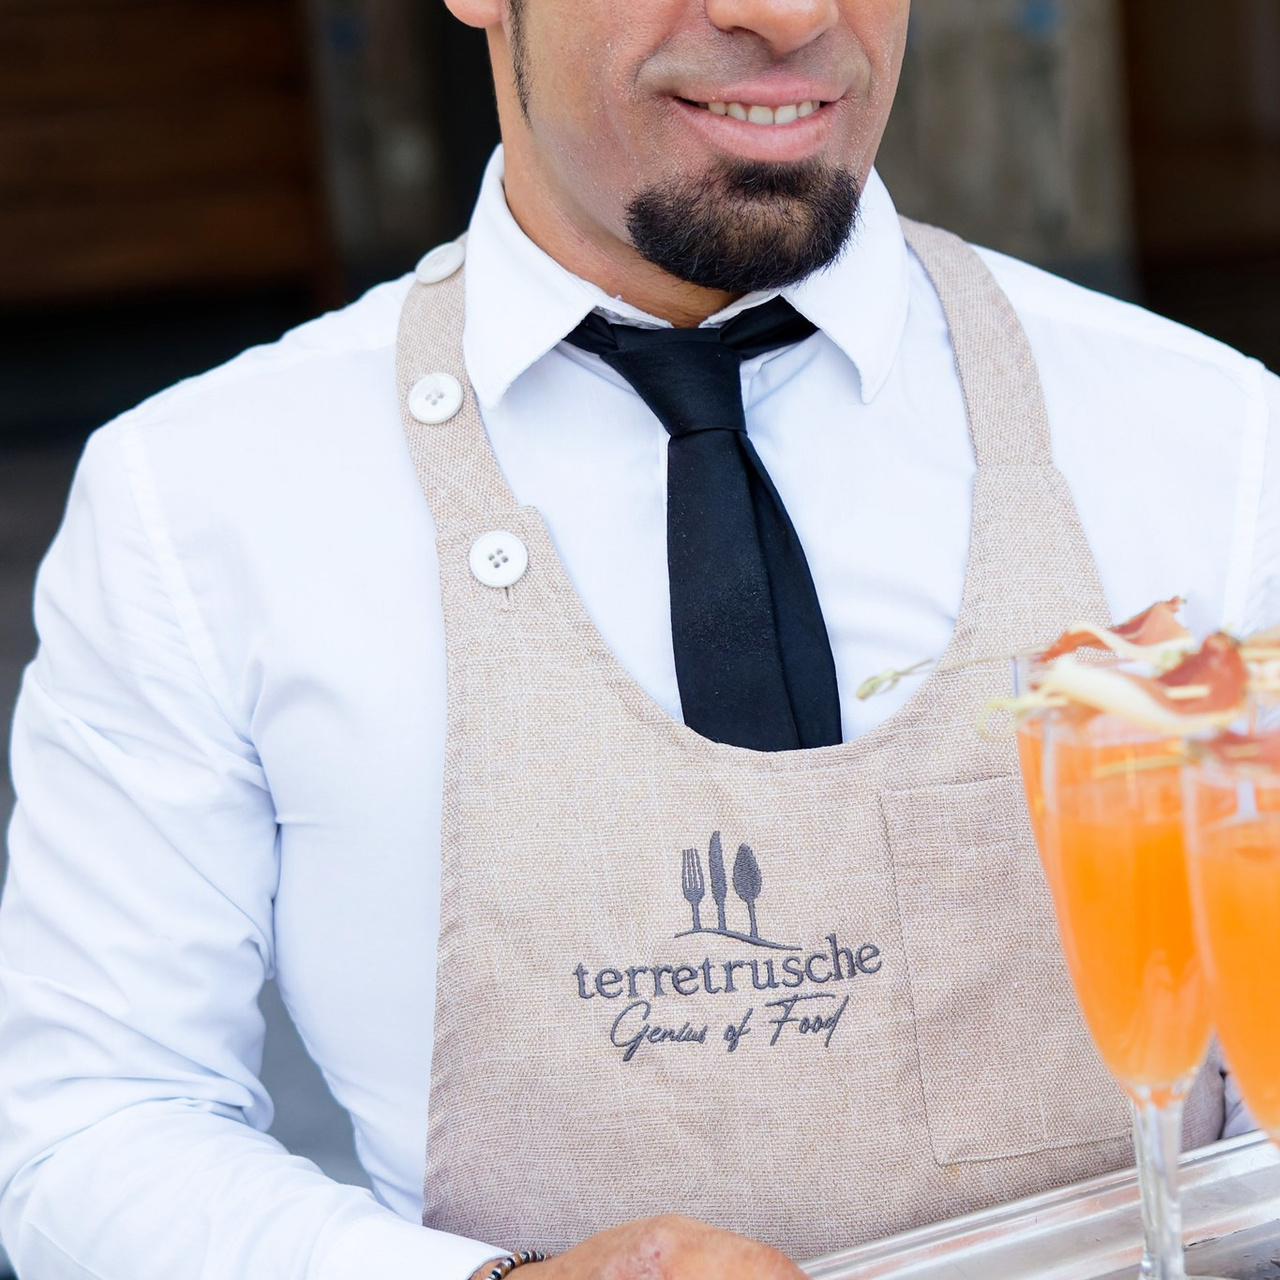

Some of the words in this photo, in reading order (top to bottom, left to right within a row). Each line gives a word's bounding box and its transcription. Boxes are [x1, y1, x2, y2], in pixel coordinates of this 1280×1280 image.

[572, 933, 882, 999] terretrusche
[609, 1000, 708, 1061] Genius
[724, 1008, 754, 1052] of
[765, 994, 850, 1048] Food
